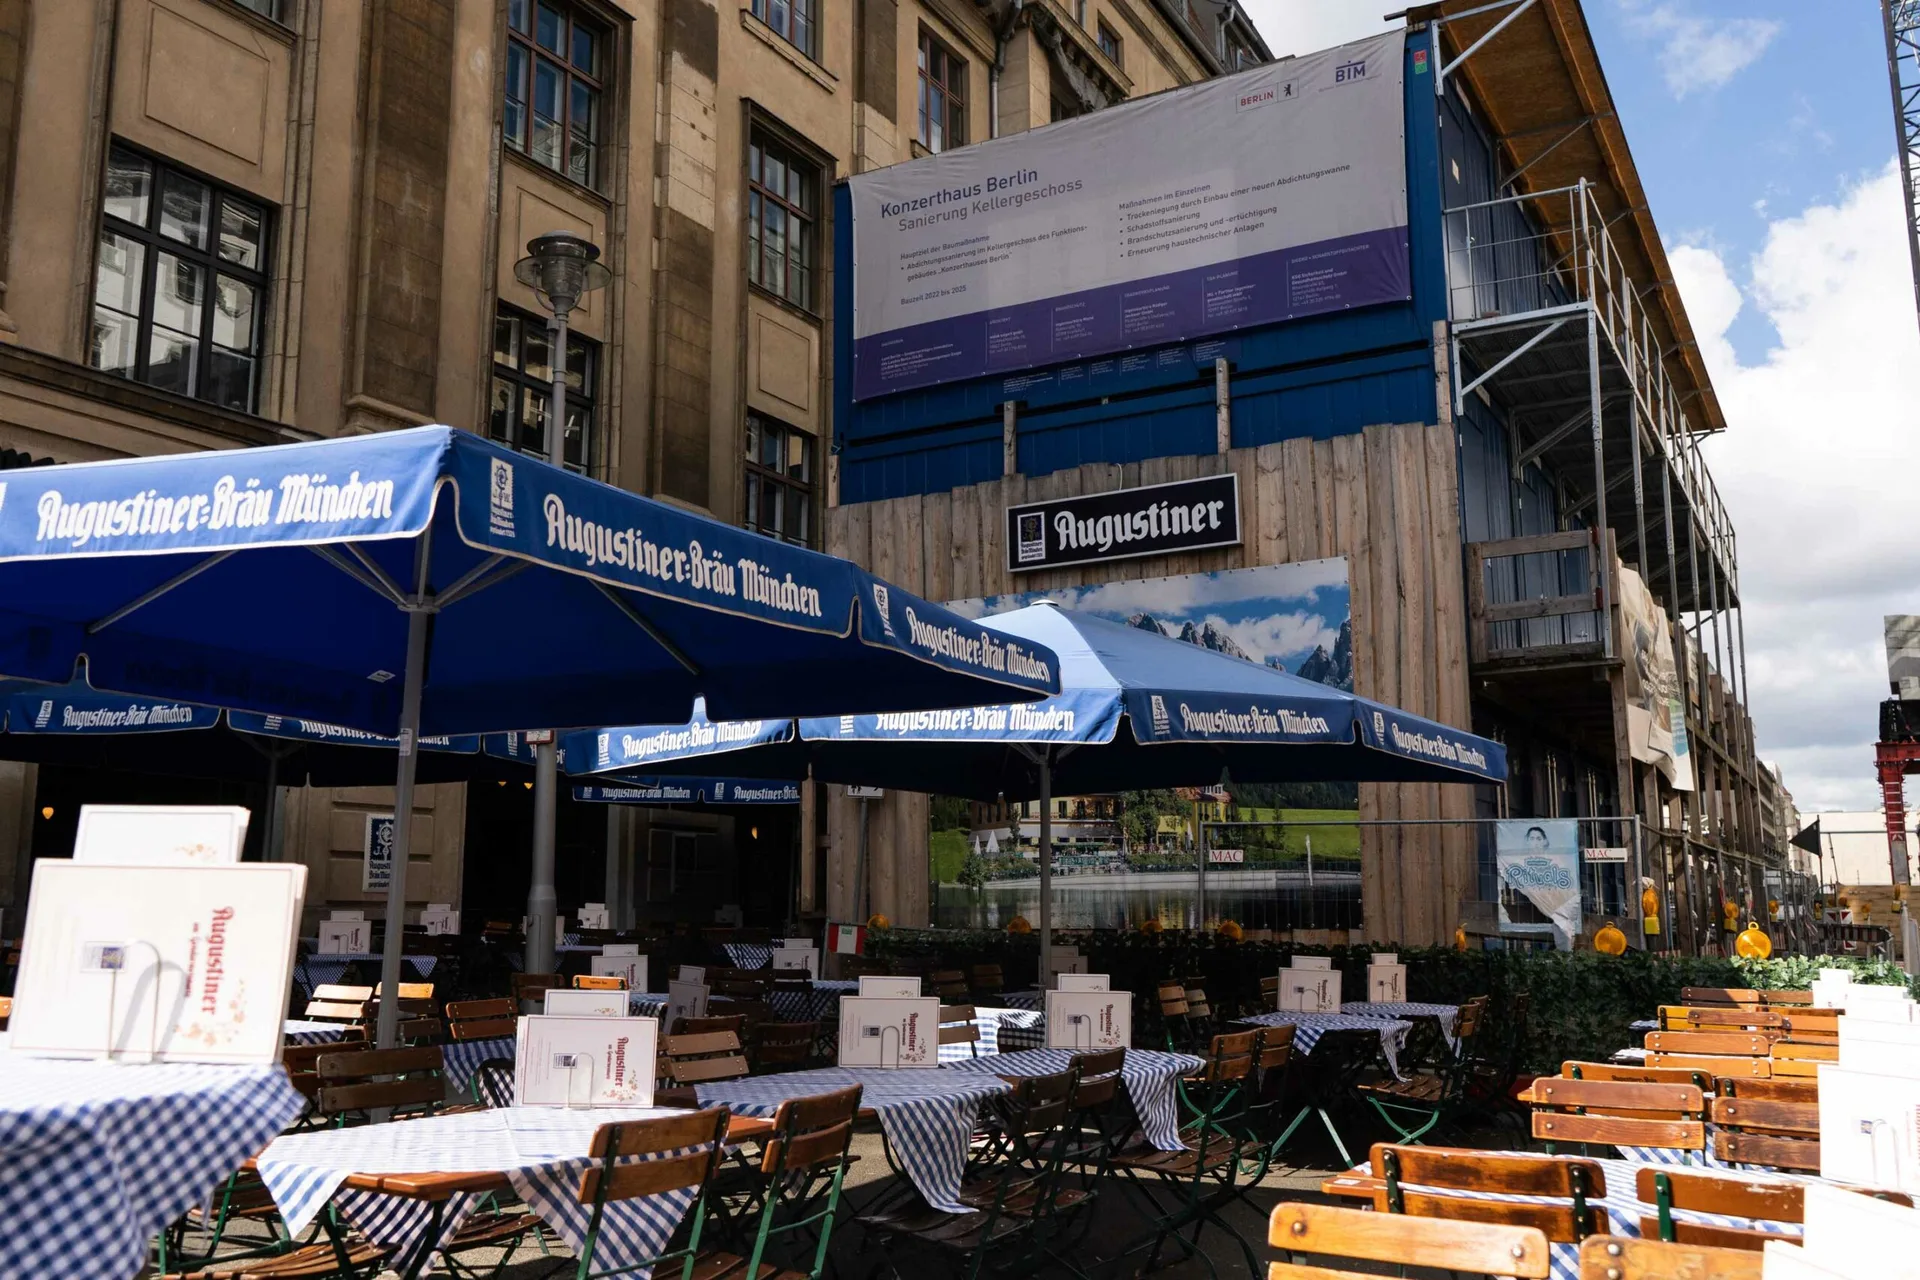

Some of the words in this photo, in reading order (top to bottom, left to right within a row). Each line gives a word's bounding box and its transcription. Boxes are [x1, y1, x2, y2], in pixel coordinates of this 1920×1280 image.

[1240, 91, 1274, 106] BERLIN
[881, 183, 982, 219] Konzerthaus
[986, 168, 1038, 193] Berlin
[898, 206, 968, 232] Sanierung
[972, 179, 1083, 214] Kellergeschoss
[1118, 195, 1162, 210] Maßnahmen
[1164, 193, 1173, 201] im
[1175, 183, 1211, 198] Einzelnen
[1127, 203, 1179, 221] Trockenlegung
[1180, 198, 1202, 209] durch
[1203, 191, 1229, 204] Einbau
[1230, 186, 1250, 198] einer
[1251, 181, 1275, 193] neuen
[1276, 164, 1351, 186] Abdichtungswanne
[1127, 211, 1200, 233] Schadstoffsanierung
[1127, 222, 1208, 245] Brandschutzsanierung
[1209, 217, 1224, 228] und
[900, 246, 929, 261] Hauptziel
[930, 245, 941, 254] der
[986, 235, 1037, 252] Kellergeschoss
[1038, 232, 1050, 242] des
[1127, 242, 1170, 258] Erneuerung
[1171, 228, 1232, 248] haustechnischer
[1233, 221, 1265, 235] Anlagen
[900, 294, 924, 306] Bauzeit
[924, 290, 940, 300] 2022
[952, 285, 967, 294] 2025
[274, 471, 394, 525] München
[1053, 500, 1225, 553] Augustiner
[737, 557, 823, 618] München
[1006, 642, 1051, 684] München
[1008, 703, 1075, 732] München
[1278, 708, 1330, 734] München
[1211, 850, 1243, 862] MAC
[1506, 863, 1573, 890] Rituals
[201, 906, 235, 1016] Augustiner
[907, 1012, 919, 1052] Augustiner
[1104, 1004, 1114, 1037] Augustiner
[614, 1036, 629, 1088] Augustiner
